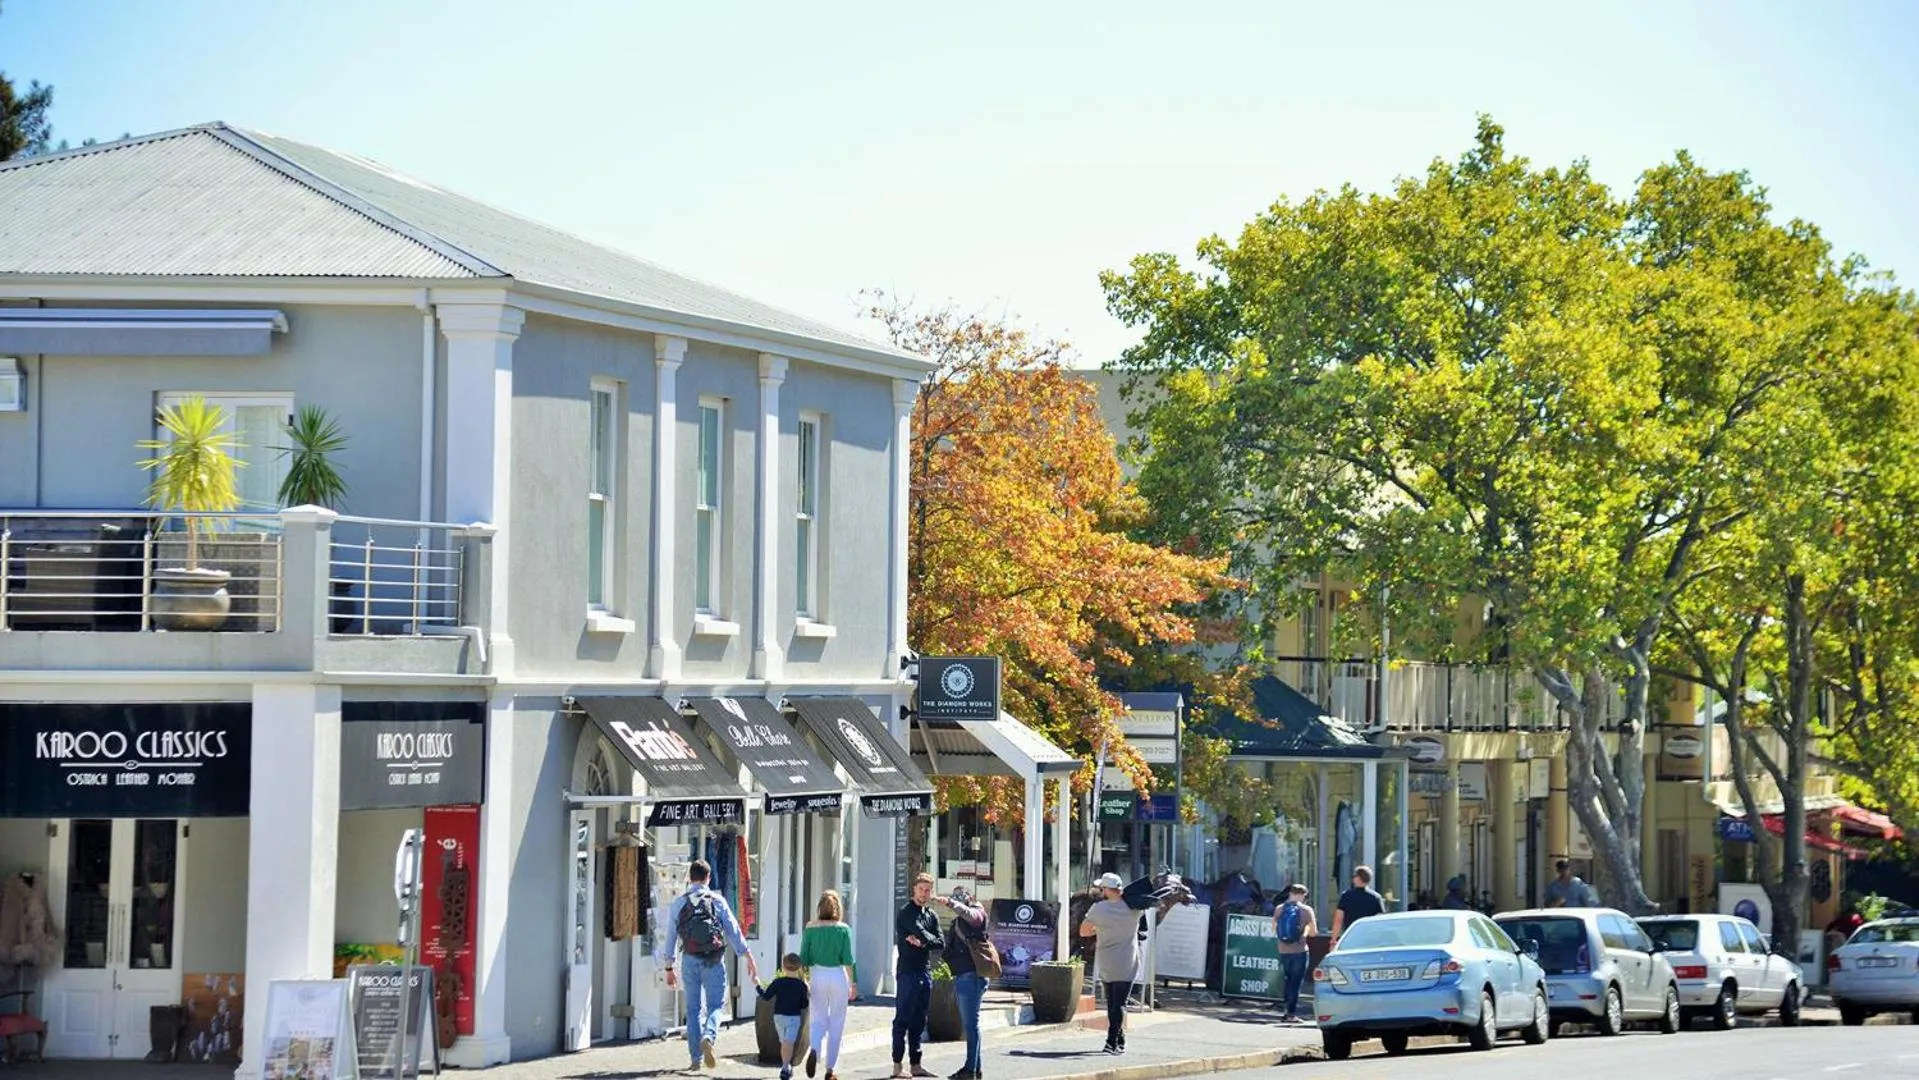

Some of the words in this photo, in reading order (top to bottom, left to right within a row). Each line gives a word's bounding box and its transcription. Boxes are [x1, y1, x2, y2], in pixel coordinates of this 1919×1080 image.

[36, 731, 128, 758] KAROO
[136, 731, 228, 758] CLASSICS
[377, 733, 415, 759] KAROO
[417, 733, 453, 758] CLASSICS
[66, 773, 108, 785] OSTRICH
[116, 773, 149, 785] LEATHER
[157, 773, 196, 785] MOHAIR
[660, 805, 681, 820] FINE
[684, 804, 699, 819] ART
[1105, 807, 1124, 816] Shop
[1233, 955, 1279, 971] LEATHER
[1240, 978, 1269, 992] SHOP
